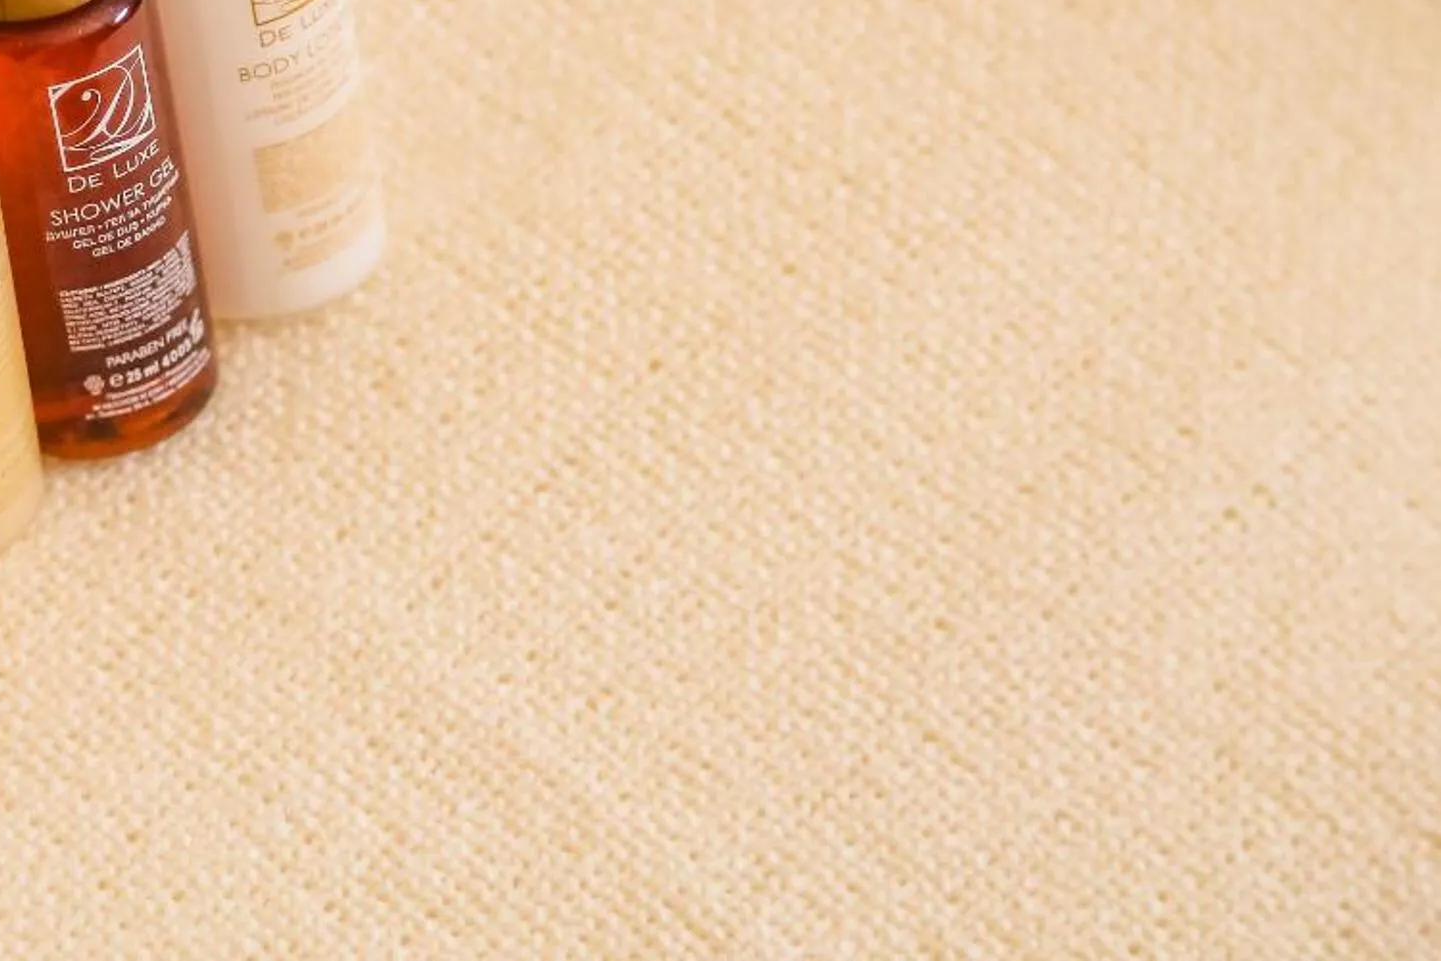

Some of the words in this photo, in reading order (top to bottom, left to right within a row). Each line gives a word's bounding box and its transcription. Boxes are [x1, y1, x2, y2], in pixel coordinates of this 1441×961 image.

[258, 24, 293, 48] DE
[238, 50, 300, 82] BODY
[67, 173, 103, 194] DE
[113, 138, 160, 178] LUXE
[50, 182, 145, 227] SHOWER
[149, 155, 175, 188] GEL
[105, 336, 165, 368] PARABEN
